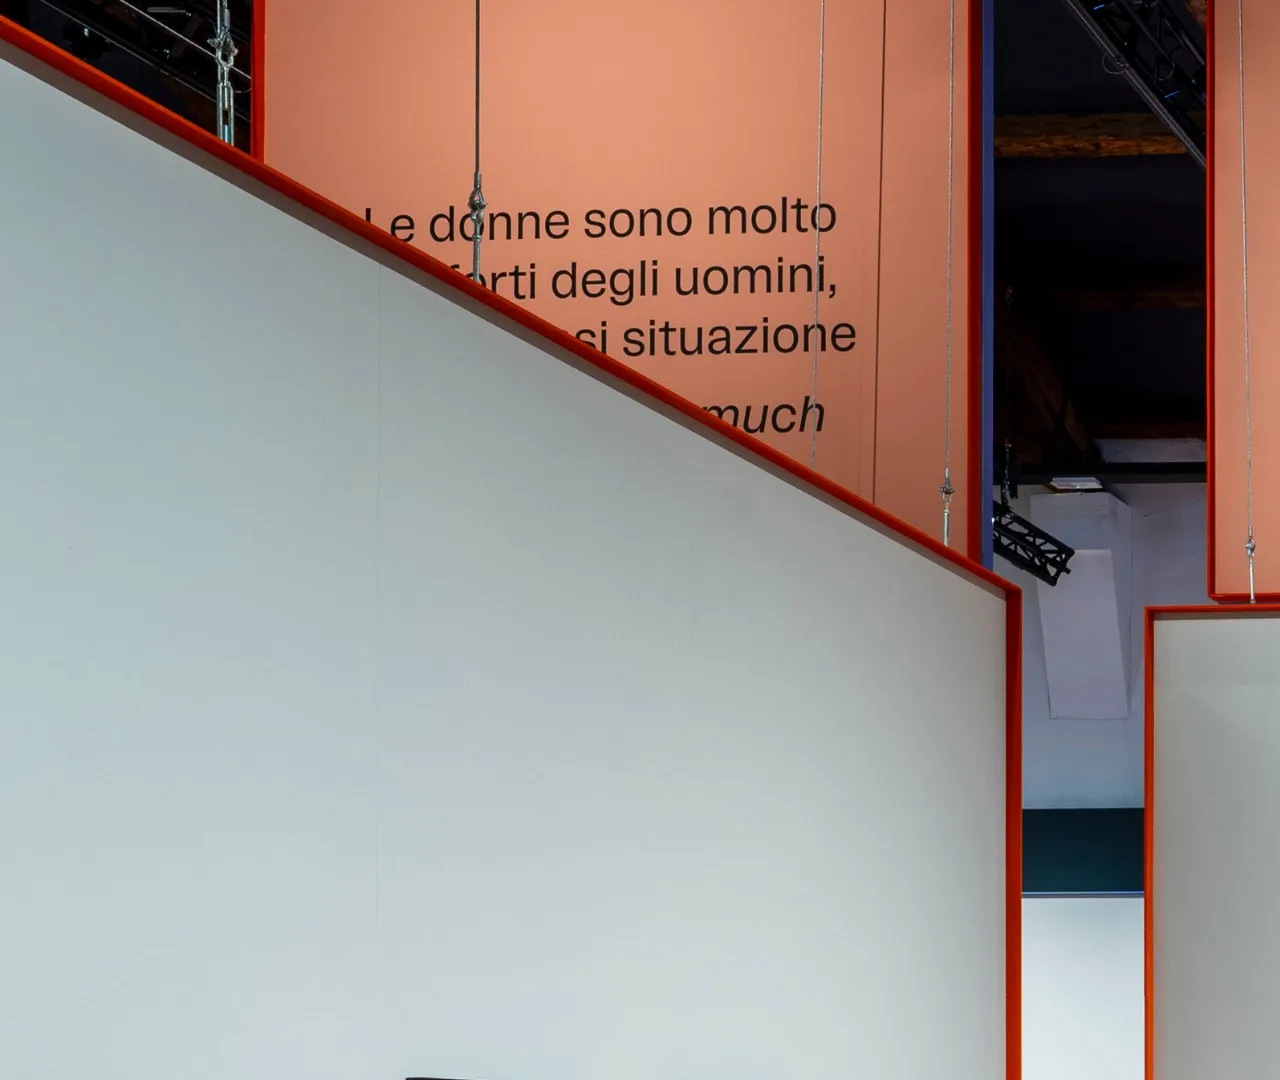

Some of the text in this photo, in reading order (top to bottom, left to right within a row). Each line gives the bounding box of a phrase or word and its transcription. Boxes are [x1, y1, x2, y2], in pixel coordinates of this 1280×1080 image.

[430, 205, 570, 243] donne
[584, 207, 693, 239] sono
[708, 197, 837, 235] molto
[551, 260, 658, 306] degli
[675, 256, 836, 299] uomini,
[622, 316, 857, 357] situazione
